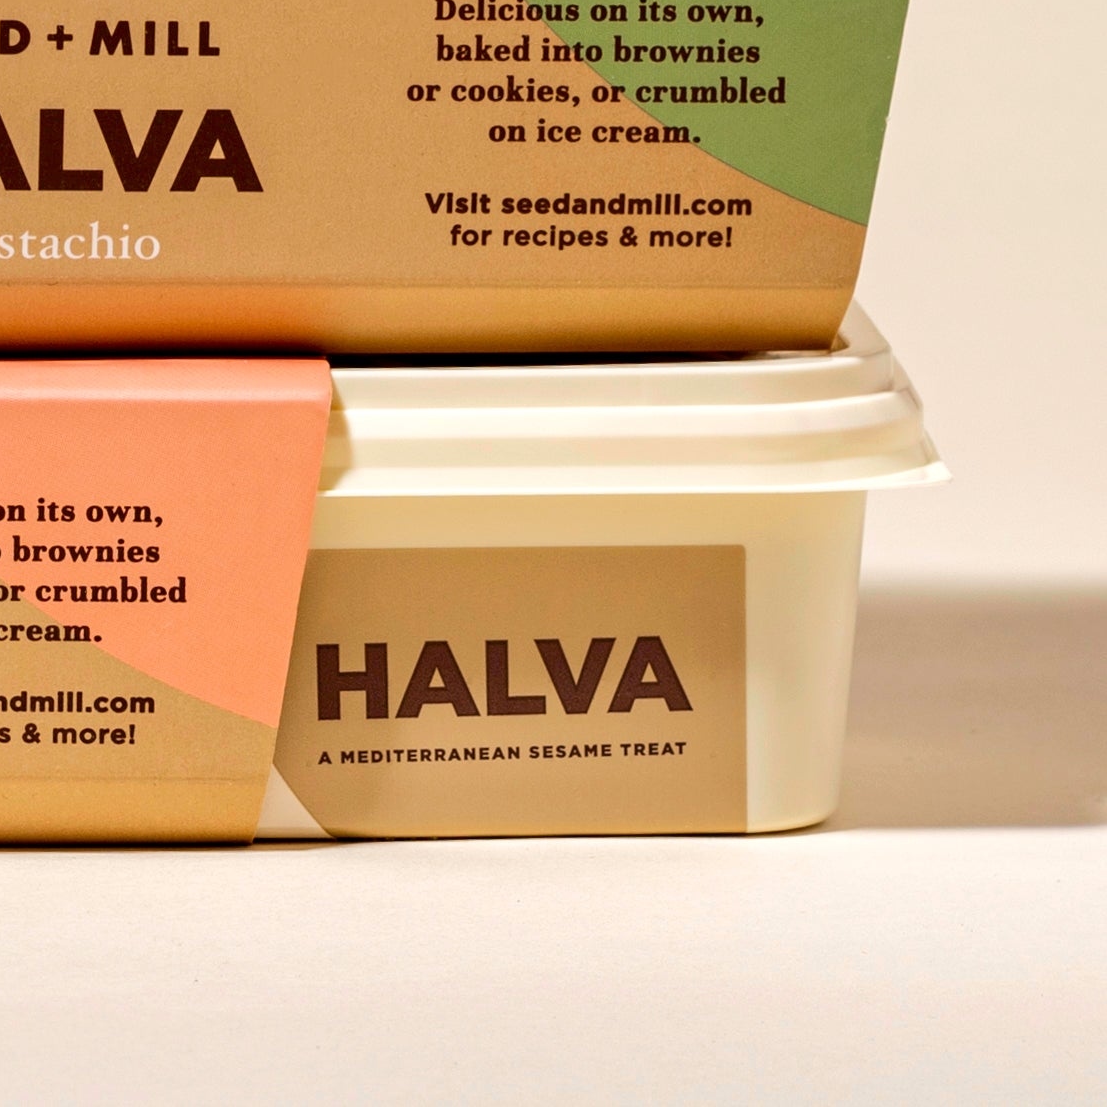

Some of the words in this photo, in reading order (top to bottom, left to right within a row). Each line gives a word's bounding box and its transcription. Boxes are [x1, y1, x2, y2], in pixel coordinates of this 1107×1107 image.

[590, 4, 628, 22] on
[687, 4, 764, 28] own,
[46, 24, 74, 51] +
[89, 20, 221, 57] MILL
[436, 34, 531, 62] baked
[541, 37, 603, 63] into
[613, 35, 760, 64] brownies
[406, 84, 442, 102] or
[450, 74, 581, 108] cookies,
[591, 85, 626, 103] or
[635, 76, 786, 104] crumbled
[488, 125, 527, 143] on
[536, 118, 582, 143] ice
[591, 125, 701, 144] cream.
[424, 192, 491, 214] Visit
[501, 192, 752, 216] seedandmill.com
[450, 223, 493, 247] for
[502, 224, 609, 251] recipes
[619, 225, 638, 247] &
[649, 226, 733, 248] more!
[36, 497, 76, 523] its
[85, 505, 163, 528] own,
[12, 534, 160, 563] brownies
[35, 575, 187, 603] crumbled
[315, 635, 694, 721] HALVA
[21, 722, 41, 744] &
[52, 723, 136, 745] more!
[317, 751, 332, 765] A
[340, 746, 520, 765] MEDITERRANEAN
[529, 744, 612, 759] SESAME
[619, 741, 687, 757] TREAT
